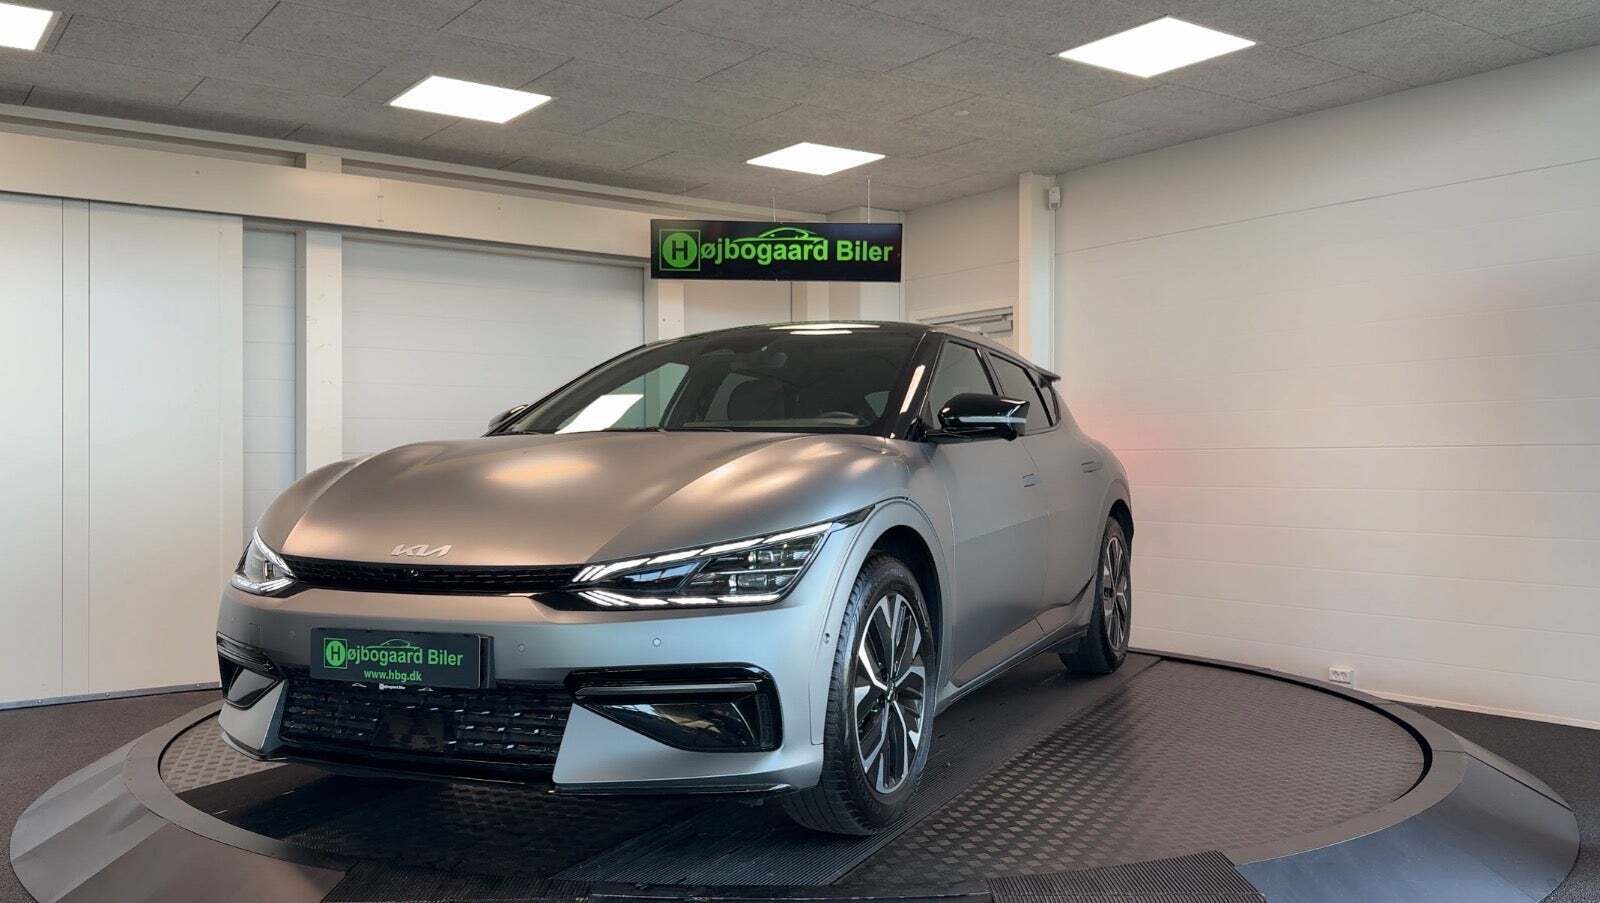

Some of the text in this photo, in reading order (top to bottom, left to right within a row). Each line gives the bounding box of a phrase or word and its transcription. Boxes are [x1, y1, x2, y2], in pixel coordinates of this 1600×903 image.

[670, 239, 893, 265] Højbogaard Biler
[330, 645, 464, 667] Højbogaard Biler
[363, 668, 423, 682] www.hbg.dk
